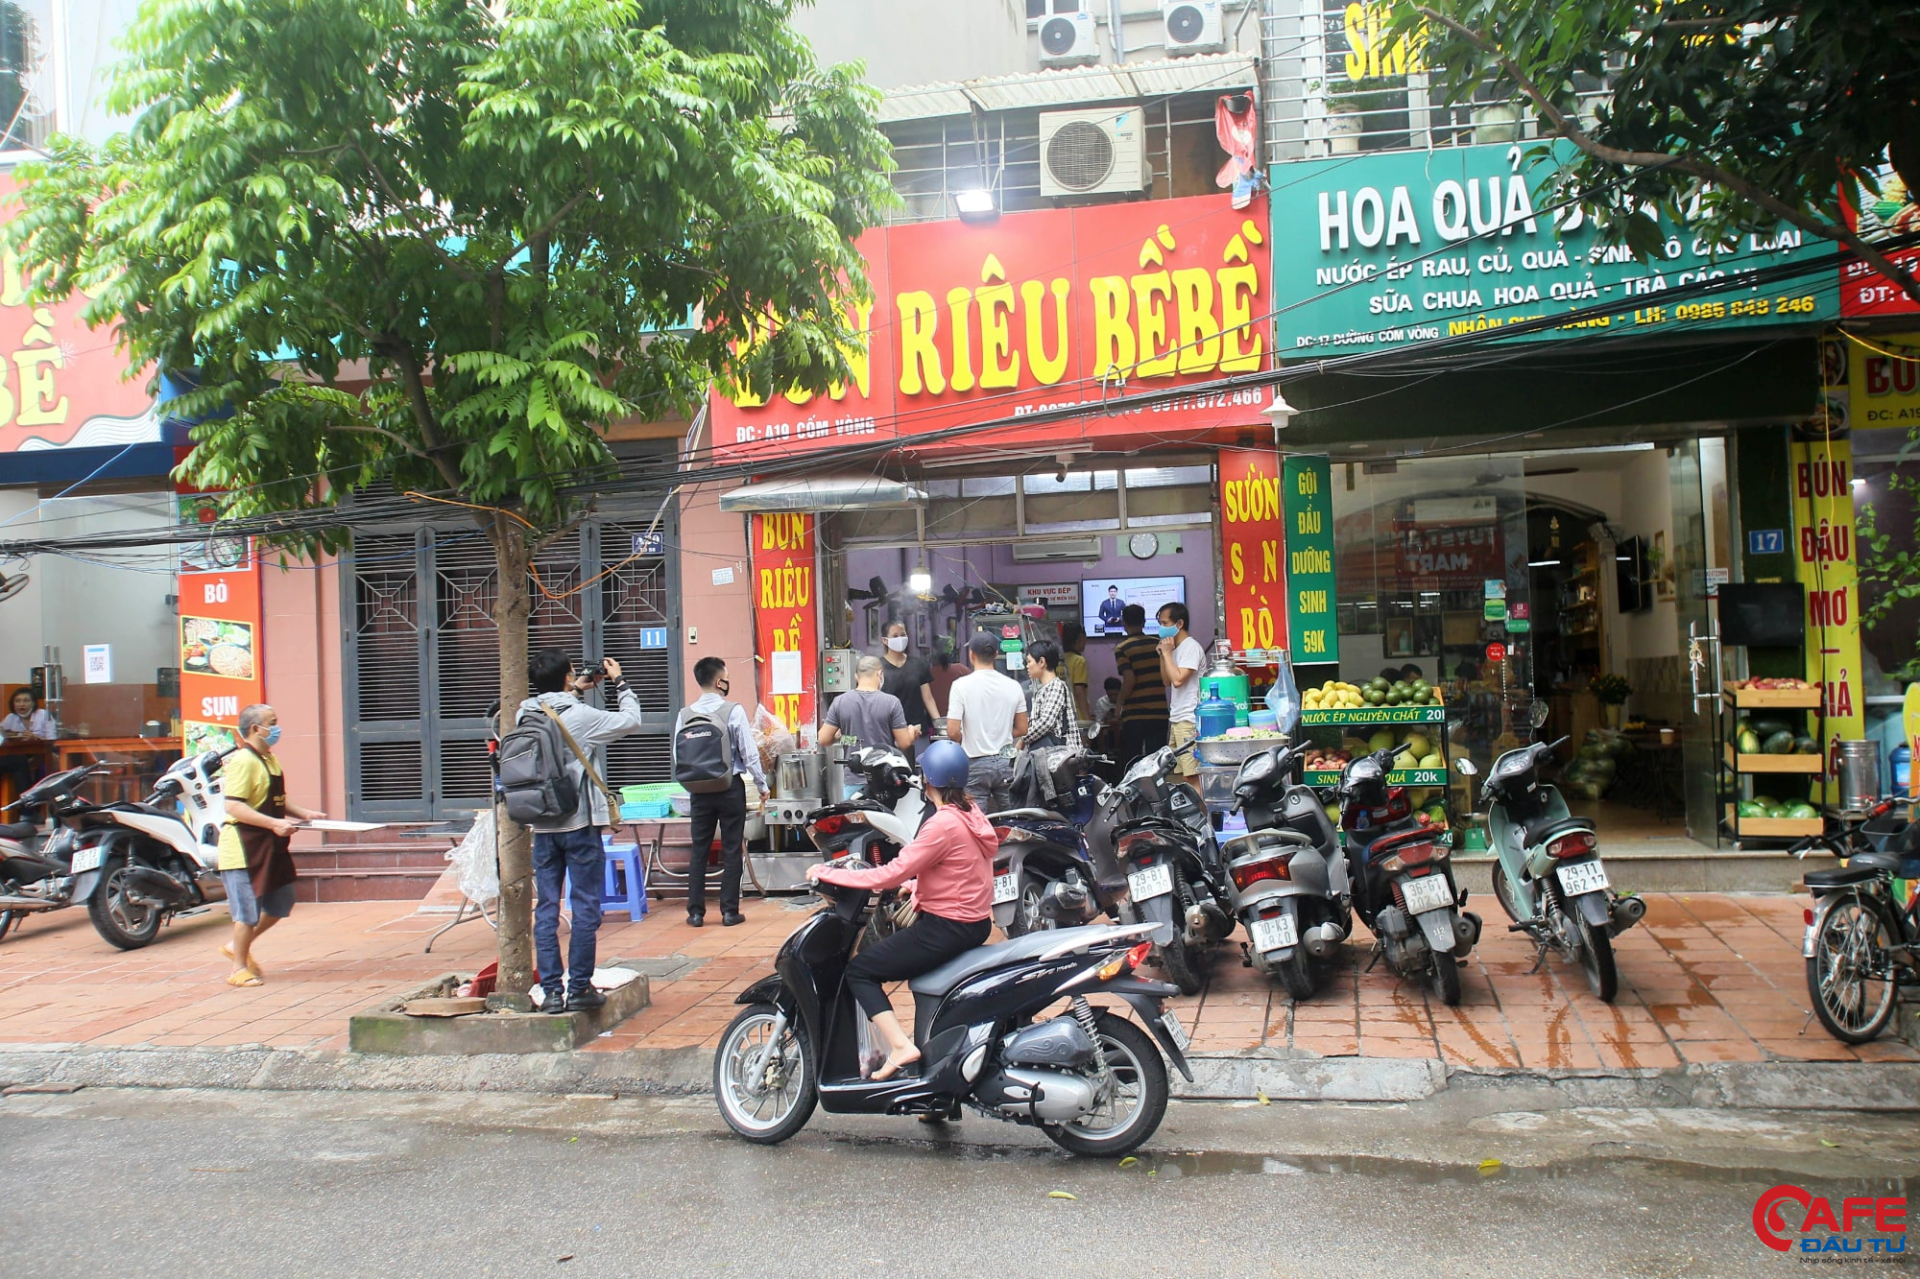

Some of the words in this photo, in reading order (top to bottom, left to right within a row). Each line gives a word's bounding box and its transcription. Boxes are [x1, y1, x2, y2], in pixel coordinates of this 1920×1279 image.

[1317, 185, 1421, 251] HOA
[1432, 145, 1538, 241] QUẢ
[1315, 257, 1377, 286] NƯỚC
[1386, 255, 1413, 280] ÉP
[1421, 255, 1471, 278] RAU,
[1477, 246, 1513, 274] CỦ,
[1521, 241, 1570, 270] QUẢ
[1369, 288, 1414, 315] SỮA
[1422, 289, 1482, 312] CHUA
[1494, 284, 1540, 306] HOA
[1549, 272, 1599, 301] QUẢ
[1621, 268, 1668, 296] TRÀ
[1859, 286, 1895, 303] ĐT:
[1634, 305, 1667, 325] LH:
[1775, 295, 1816, 314] 246
[897, 252, 1070, 397] RIÊU
[1378, 325, 1405, 342] CỐM
[1406, 324, 1440, 341] VÒNG
[1865, 346, 1920, 395] BÚ
[796, 414, 829, 439] CỐM
[835, 414, 876, 437] VÒNG
[1867, 409, 1894, 422] ĐC:
[1298, 466, 1318, 500] GỘI
[1797, 453, 1848, 498] BÚN
[1224, 462, 1280, 523] SƯỜN
[1755, 532, 1778, 551] 17
[1801, 517, 1849, 571] ĐẬU
[1291, 546, 1331, 574] DƯỠNG
[204, 578, 228, 604] BÒ
[760, 556, 811, 609] RIÊU
[1027, 588, 1042, 596] KHU
[1299, 590, 1327, 614] SINH
[1808, 585, 1848, 627] MƠ
[1240, 594, 1275, 650] BÒ
[645, 630, 662, 646] 11
[1303, 629, 1326, 654] 59K
[202, 696, 238, 721] SỤN
[1302, 711, 1331, 724] NƯỚC
[1332, 711, 1346, 722] ÉP
[1347, 710, 1391, 722] NGUYÊN
[1392, 707, 1421, 721] CHẤT
[1414, 771, 1438, 783] 20k
[1134, 869, 1164, 886] 29-B1
[1564, 862, 1598, 880] 29-T1
